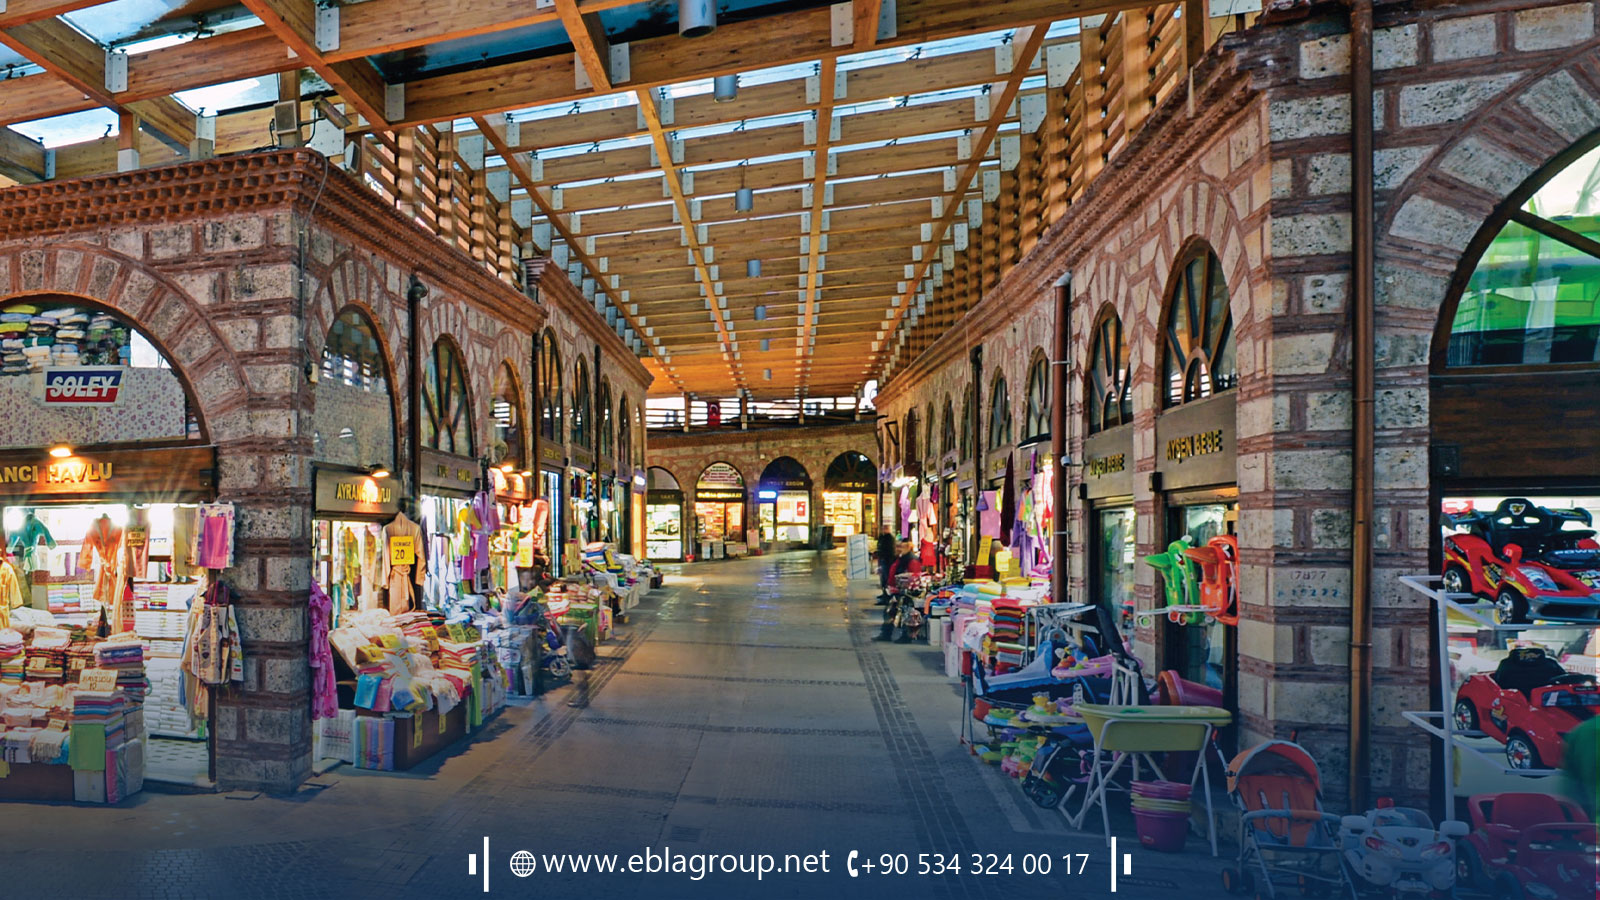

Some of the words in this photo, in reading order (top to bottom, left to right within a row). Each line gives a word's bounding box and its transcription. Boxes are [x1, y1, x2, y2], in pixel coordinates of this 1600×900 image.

[50, 375, 115, 397] SOLEY
[1194, 430, 1222, 456] BEBE
[46, 463, 113, 483] HAVLU
